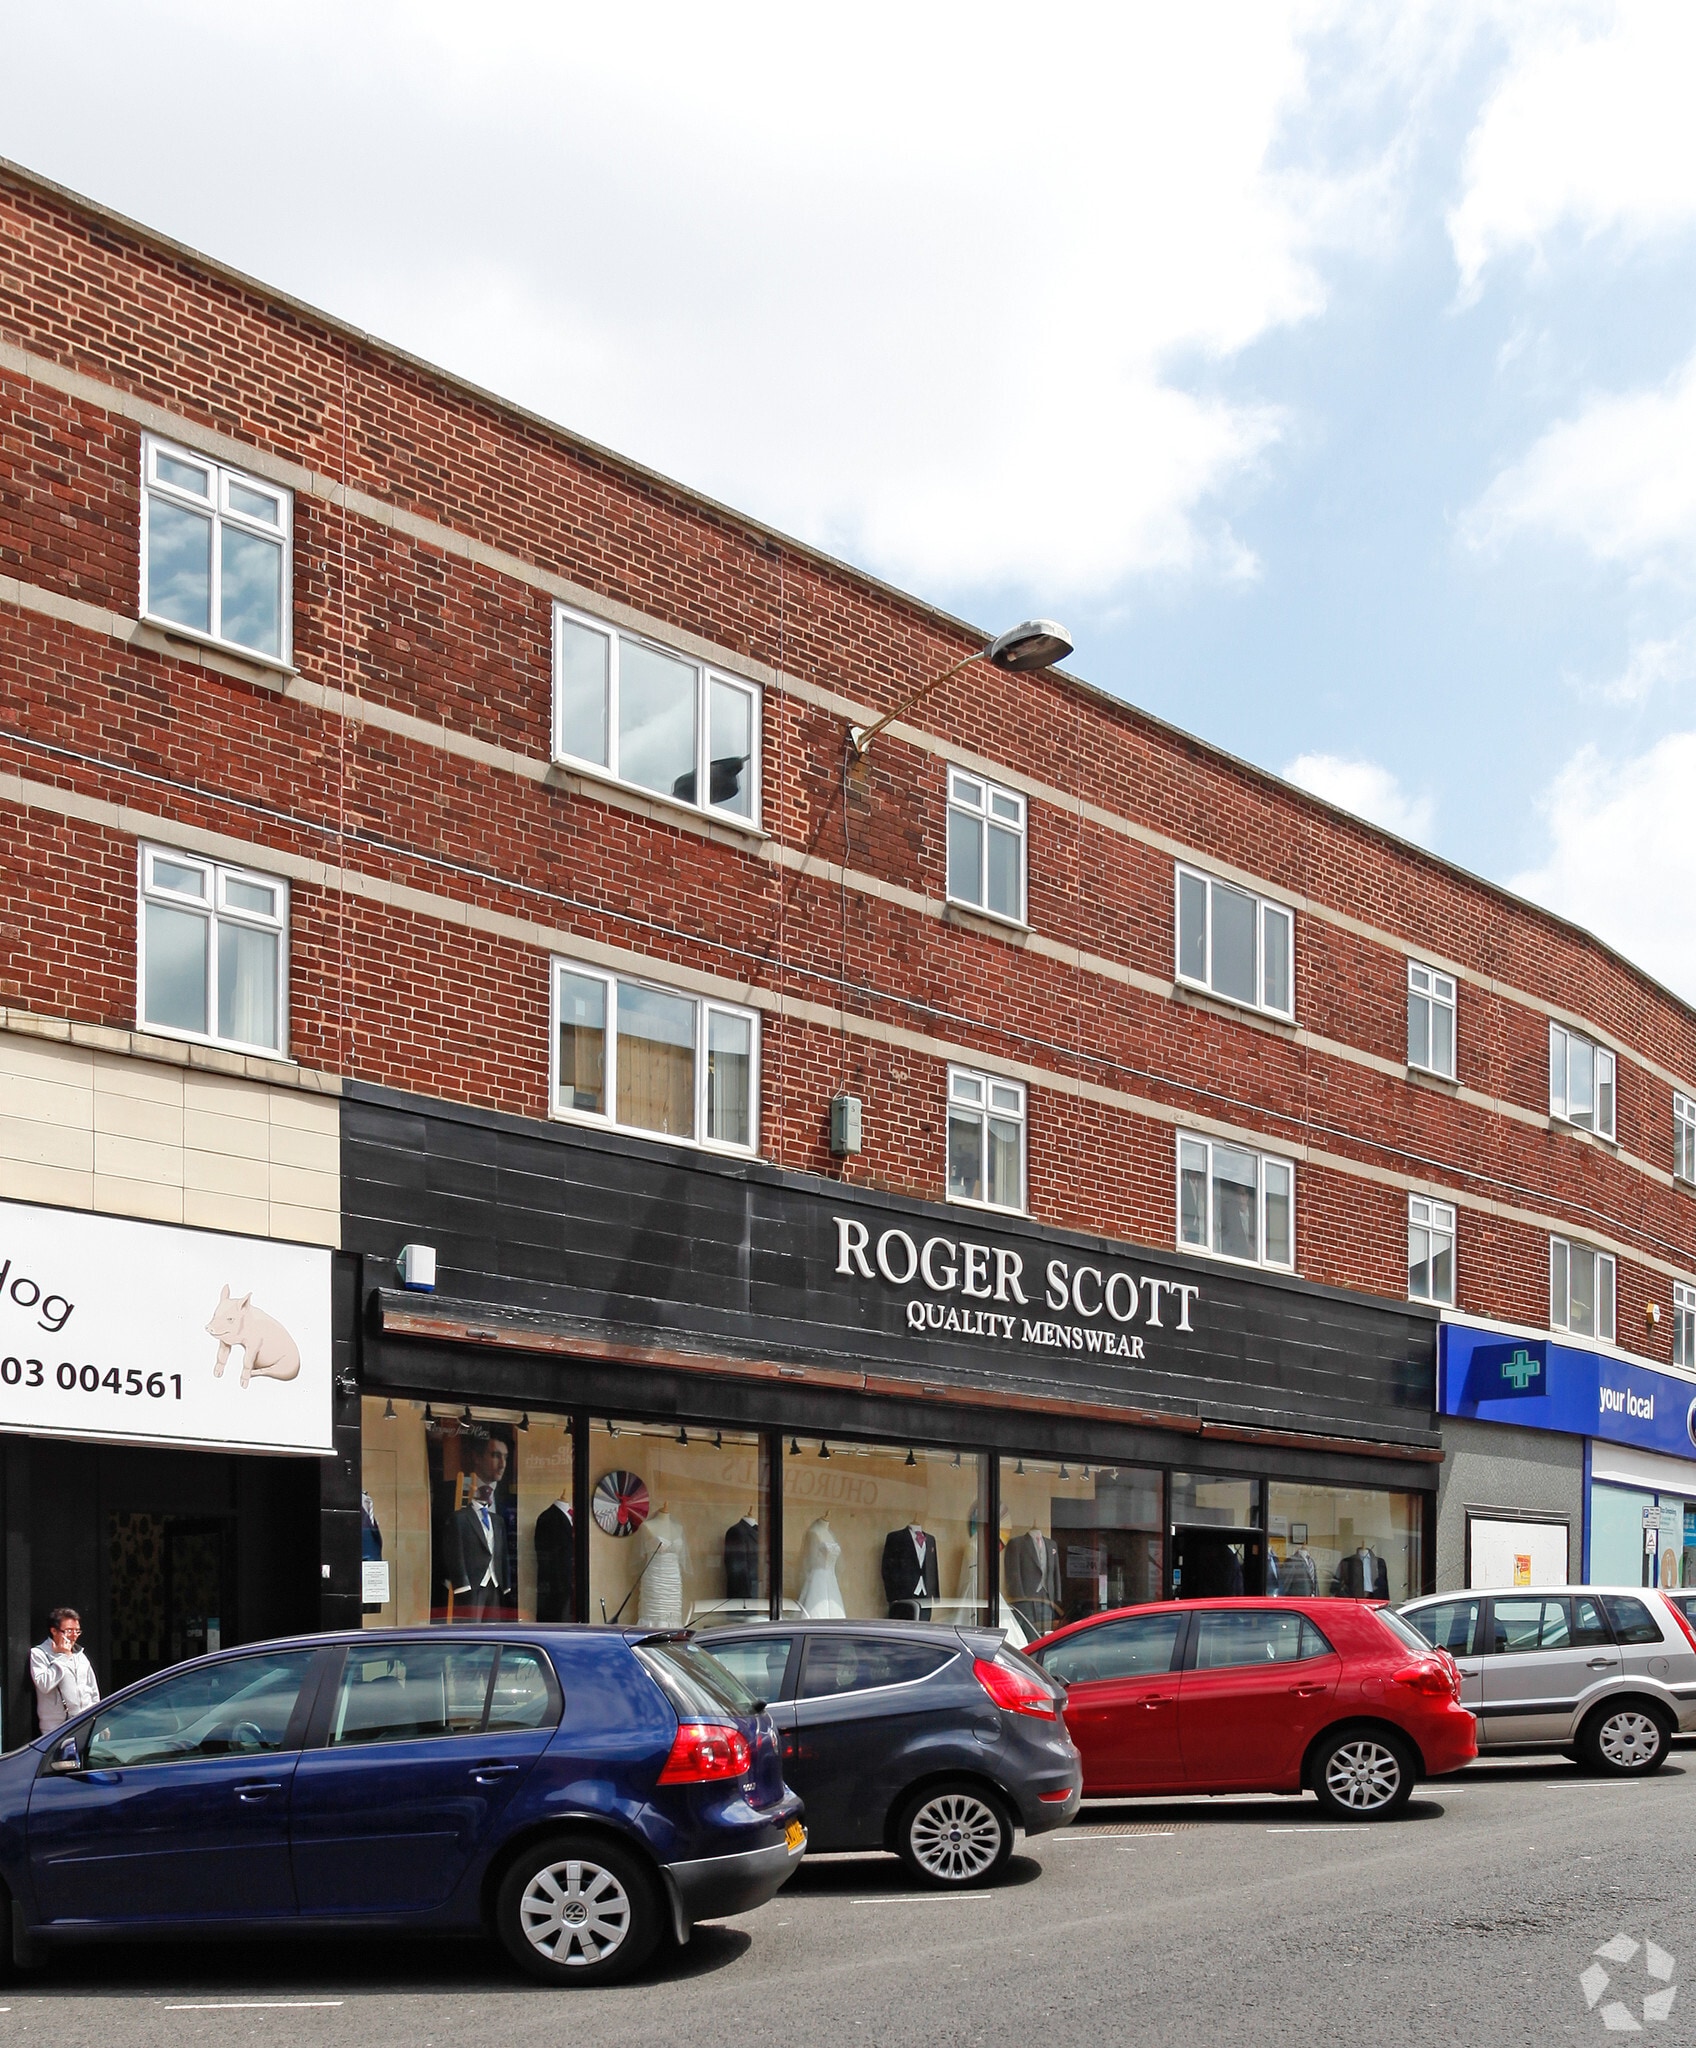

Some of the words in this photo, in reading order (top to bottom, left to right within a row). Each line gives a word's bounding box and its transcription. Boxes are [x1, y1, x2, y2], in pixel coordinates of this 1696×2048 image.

[832, 1216, 1029, 1305] ROGER
[1045, 1259, 1199, 1332] SCOTT
[906, 1300, 1016, 1340] QUALITY
[1021, 1318, 1145, 1360] MENSWEAR
[1, 1356, 44, 1387] 03
[56, 1362, 181, 1400] 004561
[1599, 1386, 1625, 1413] your
[1626, 1388, 1655, 1420] local
